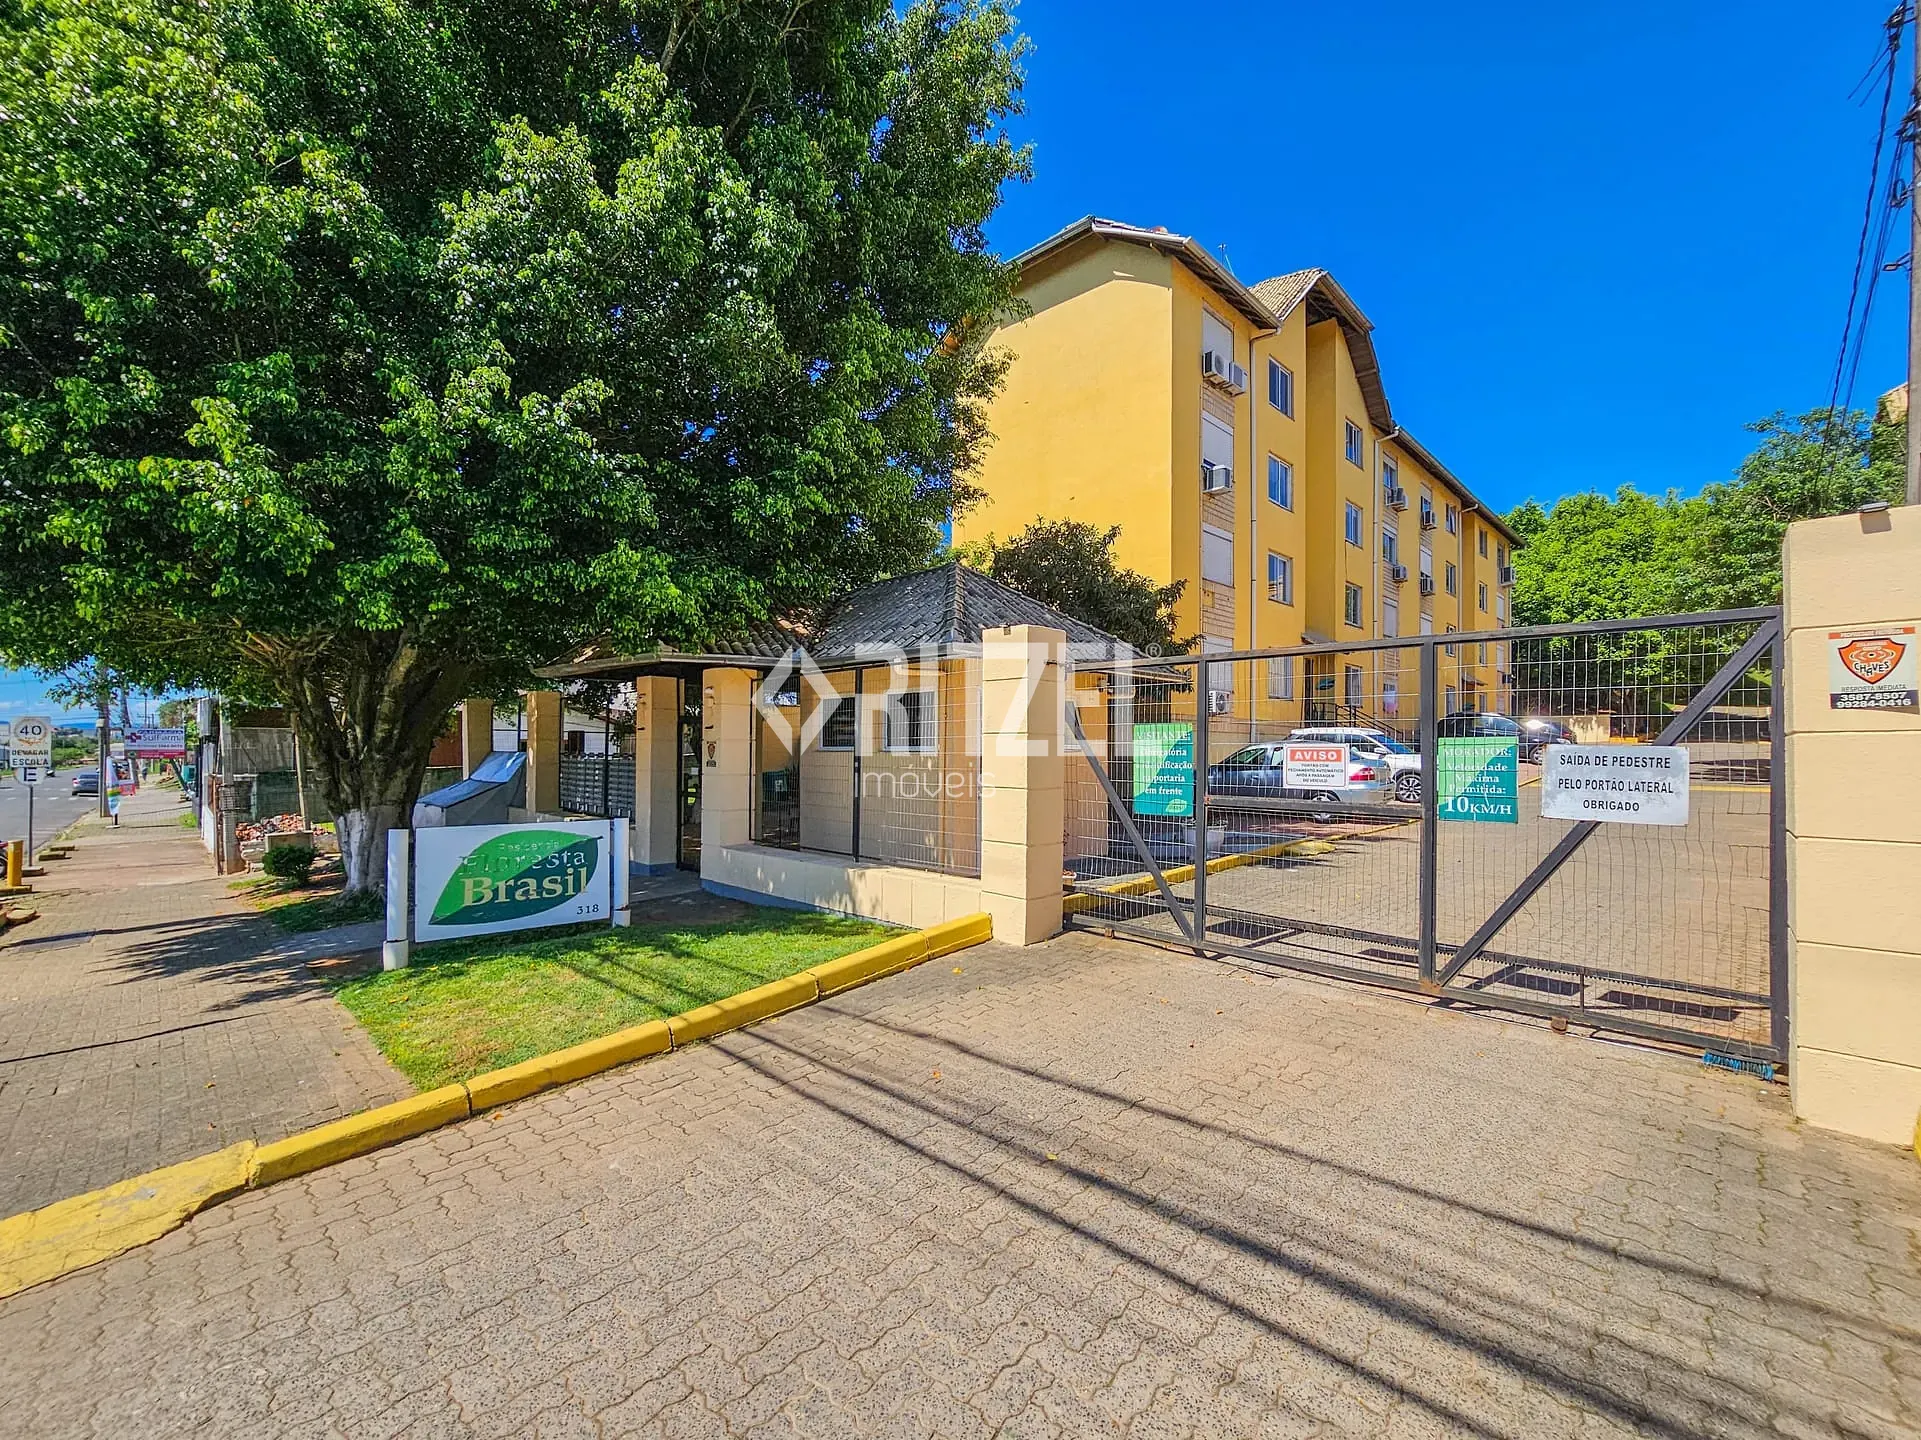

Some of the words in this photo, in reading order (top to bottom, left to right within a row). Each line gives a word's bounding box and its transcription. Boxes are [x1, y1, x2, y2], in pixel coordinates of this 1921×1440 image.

[1854, 661, 1889, 676] CHAVES
[19, 725, 42, 736] 40
[12, 758, 49, 766] ESCOLA
[1294, 751, 1338, 761] AVISO
[1560, 752, 1591, 766] SAÍDA
[1594, 755, 1608, 767] DE
[1611, 755, 1671, 769] PEDESTRE
[1447, 762, 1508, 771] Velocidade
[1448, 783, 1506, 794] Permitida:
[1558, 778, 1582, 790] PELO
[1585, 778, 1625, 792] PORTÃO
[1628, 781, 1674, 793] LATERAL
[1583, 799, 1640, 812] OBRIGADO
[460, 867, 588, 907] Brasil
[576, 903, 600, 915] 318
